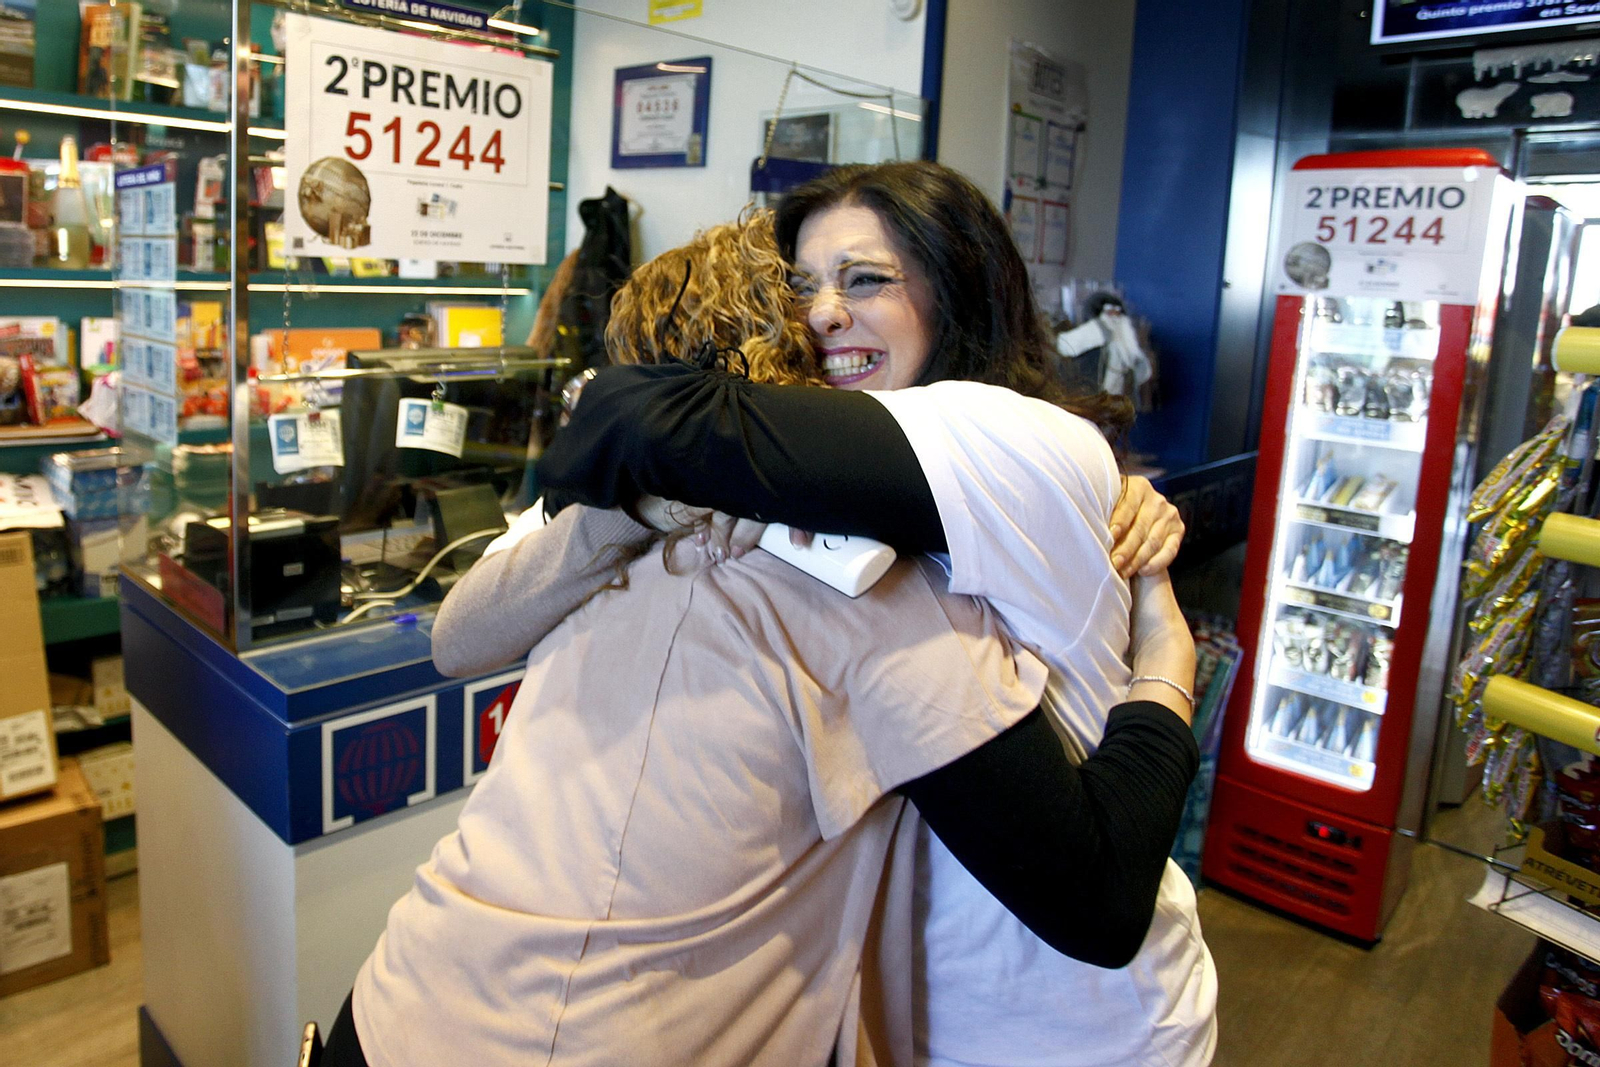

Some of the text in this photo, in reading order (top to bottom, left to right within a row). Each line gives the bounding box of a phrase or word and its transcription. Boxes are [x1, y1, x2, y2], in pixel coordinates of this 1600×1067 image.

[411, 3, 428, 17] DE
[430, 7, 483, 28] NAVIDAD
[1416, 8, 1467, 20] Quinto
[1468, 1, 1524, 16] premio
[1539, 7, 1562, 17] en
[344, 111, 506, 173] 51244
[1316, 215, 1445, 246] 51244
